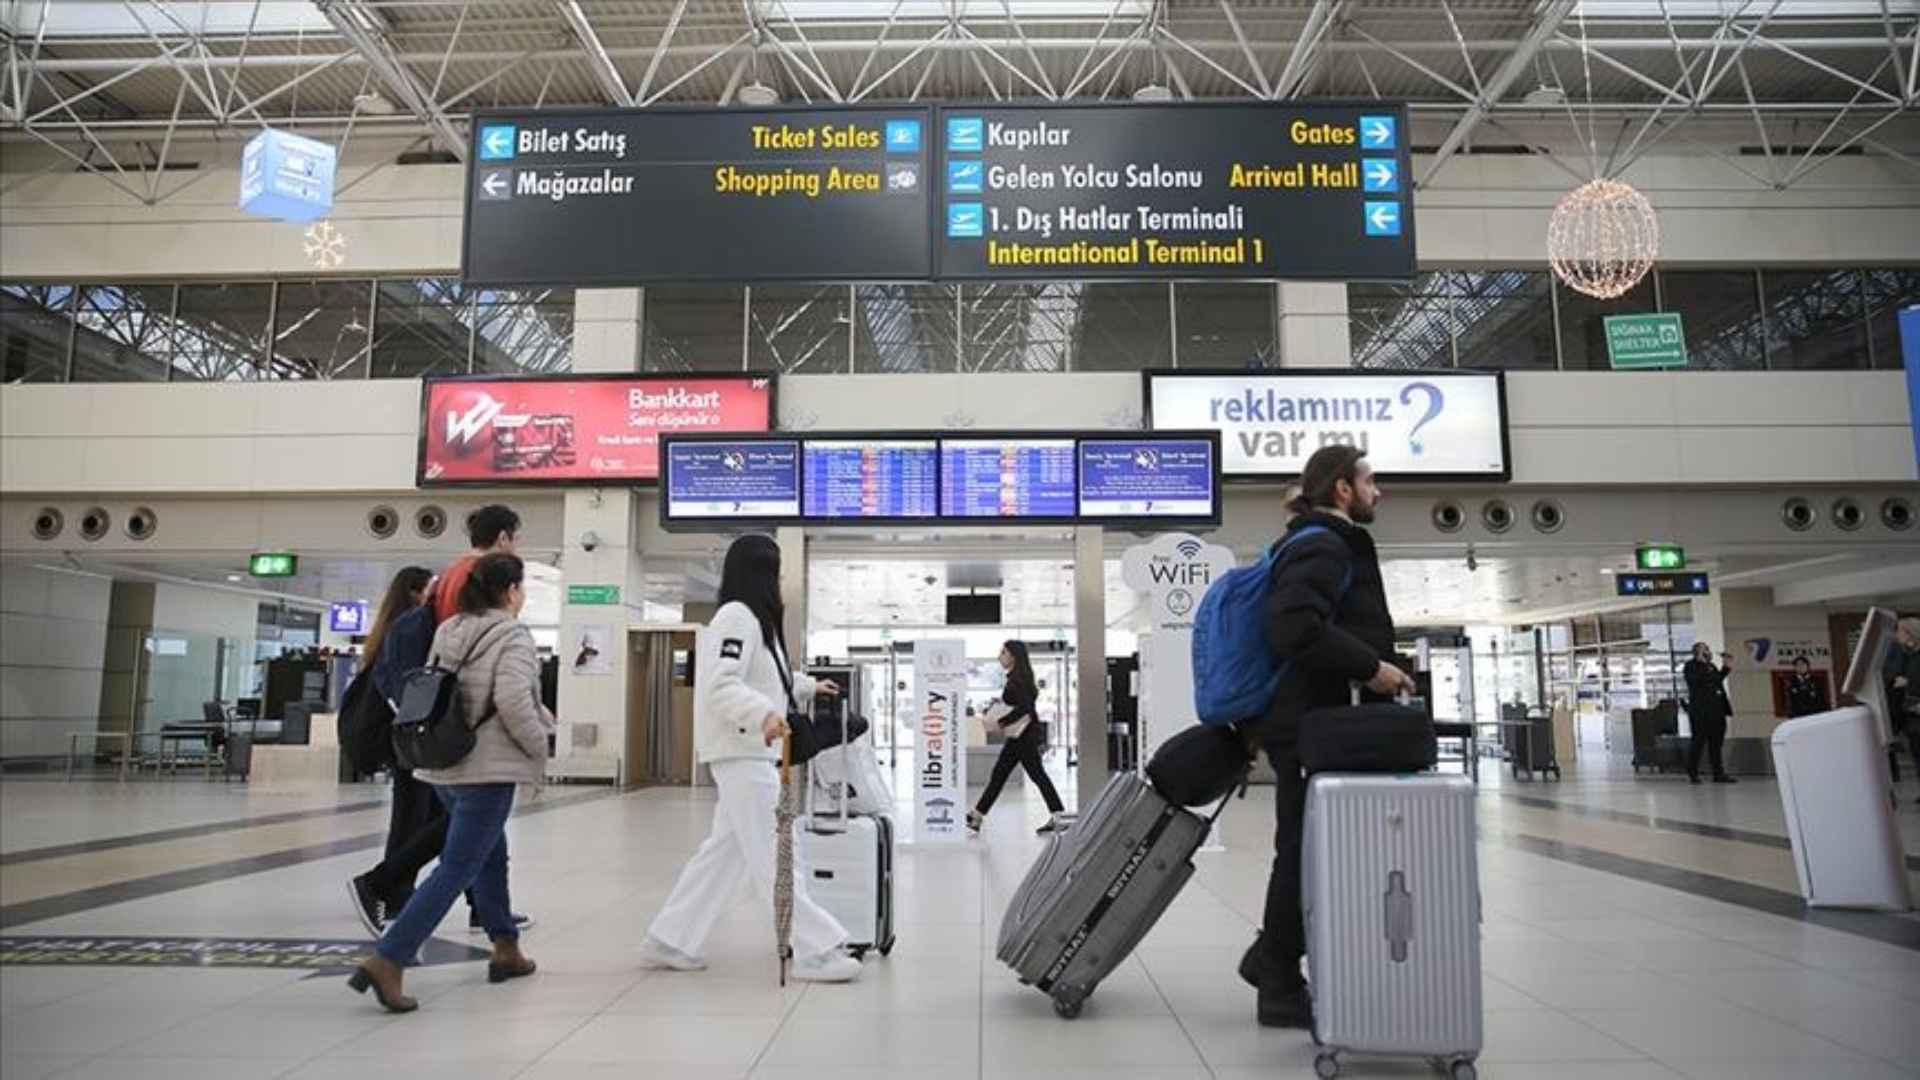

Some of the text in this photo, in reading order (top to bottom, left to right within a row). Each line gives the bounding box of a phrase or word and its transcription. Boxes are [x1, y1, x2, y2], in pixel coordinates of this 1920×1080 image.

[519, 128, 627, 158] Bilet Satış
[752, 124, 880, 148] Ticket Sales
[988, 121, 1071, 150] Kapılar
[1290, 120, 1355, 144] Gates
[517, 168, 634, 201] Mağazalar
[715, 166, 880, 197] Shopping Area
[988, 164, 1203, 188] Gelen Yolcu Salonu
[1229, 162, 1358, 188] Arrival Hall
[989, 204, 1243, 237] 1. Dış Hatlar Terminali
[989, 238, 1264, 264] International Terminal 1
[628, 388, 720, 409] Bankkart
[1209, 388, 1393, 423] reklamınız
[1239, 428, 1306, 457] var
[1148, 562, 1210, 585] WiFi
[922, 690, 947, 788] libra(i)ry
